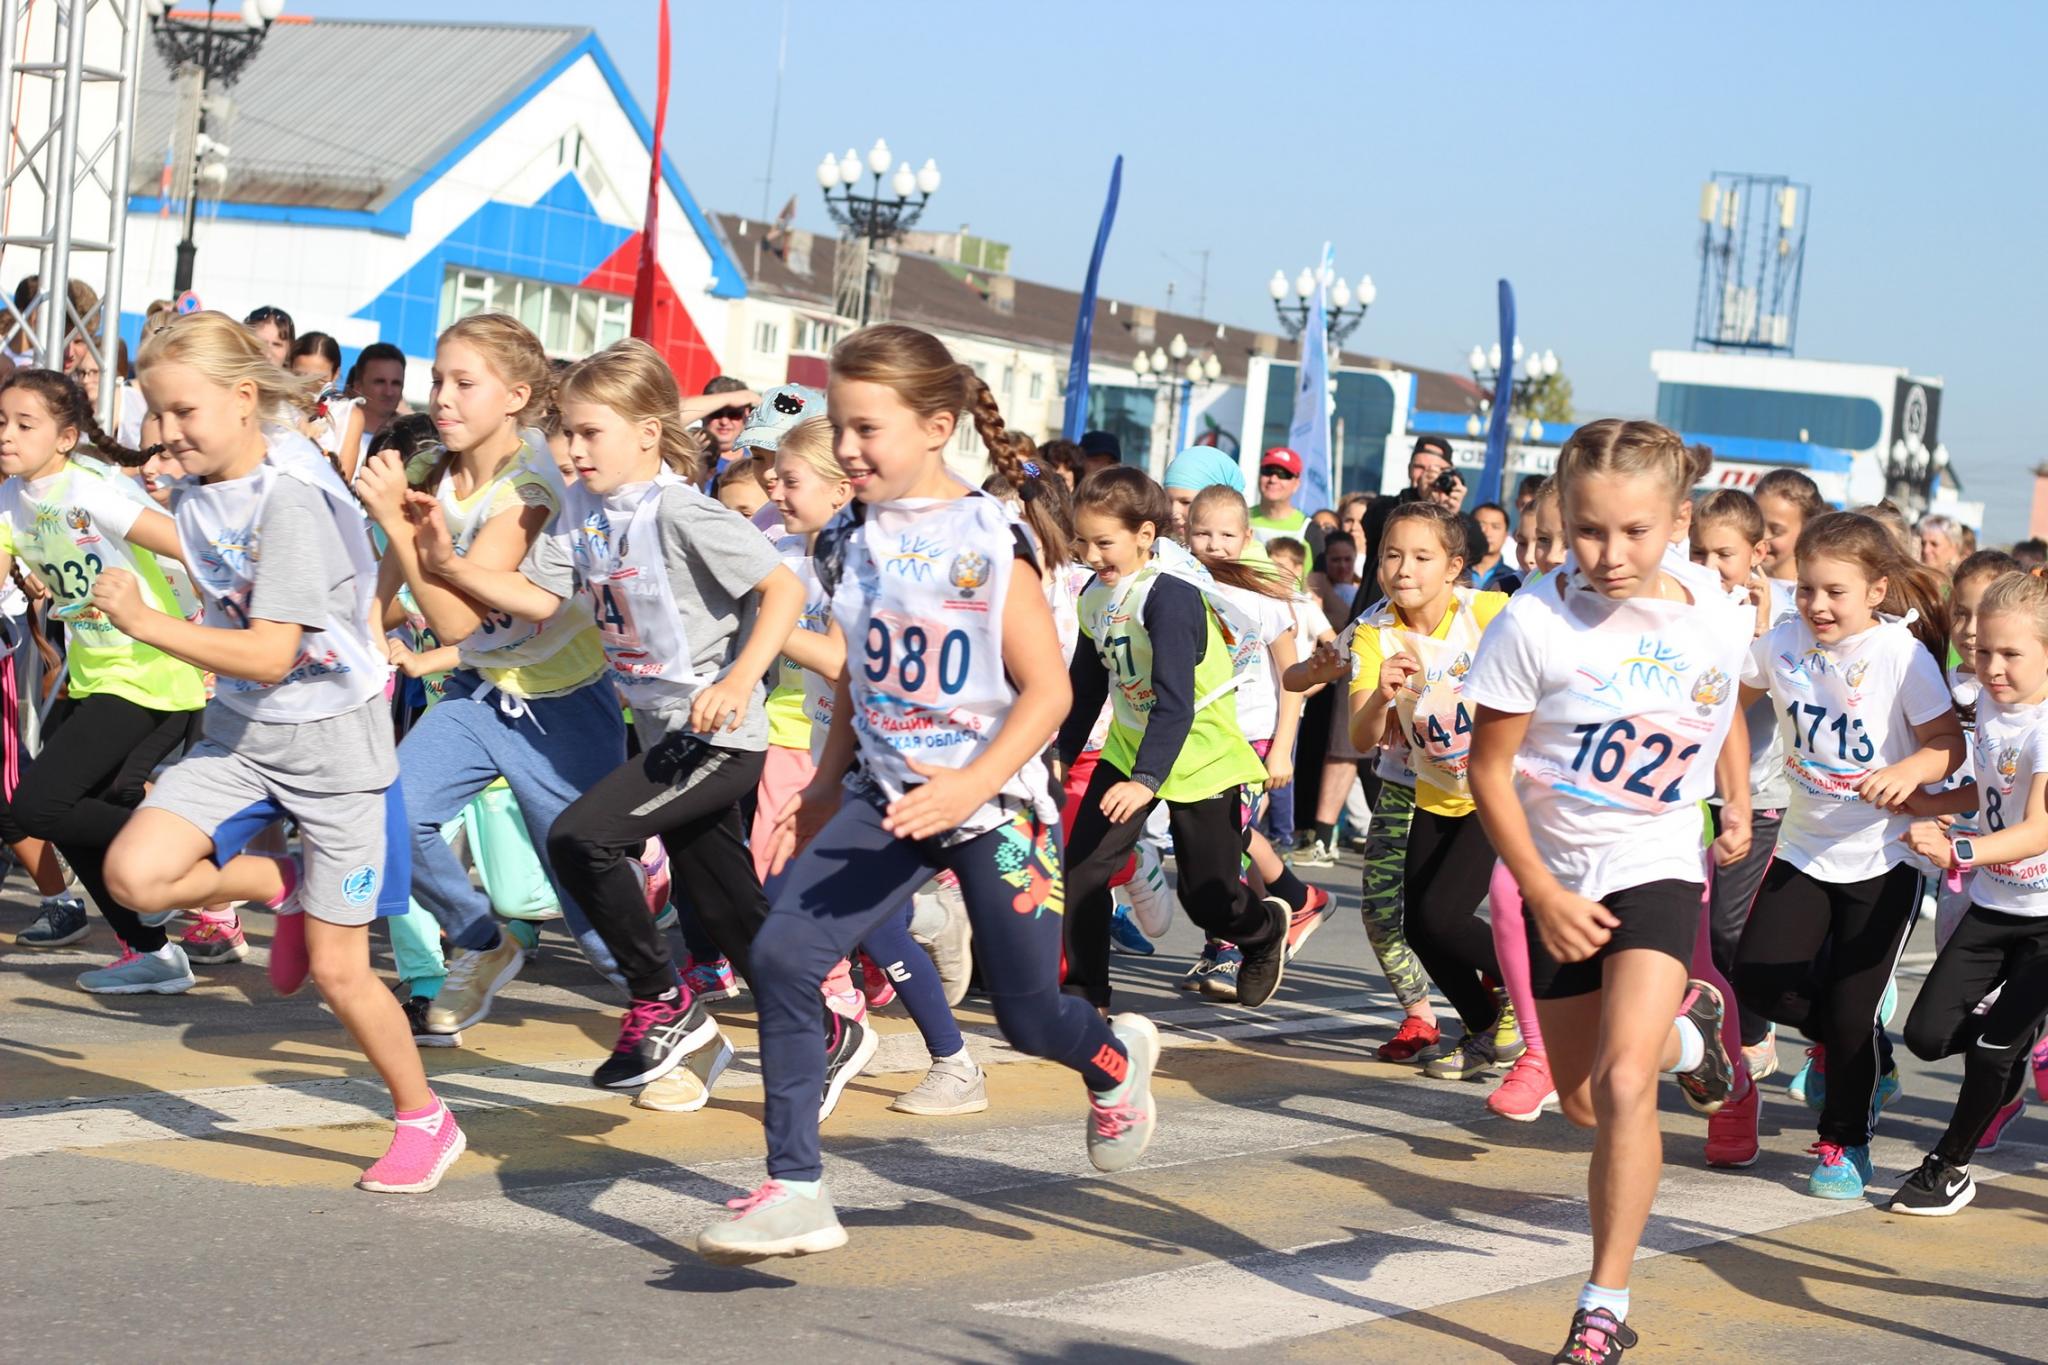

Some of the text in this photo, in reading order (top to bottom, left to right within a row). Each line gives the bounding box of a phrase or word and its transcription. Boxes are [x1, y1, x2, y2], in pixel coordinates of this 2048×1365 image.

[863, 617, 970, 695] 980
[1786, 700, 1874, 763] 1713
[2020, 863, 2048, 880] 2018
